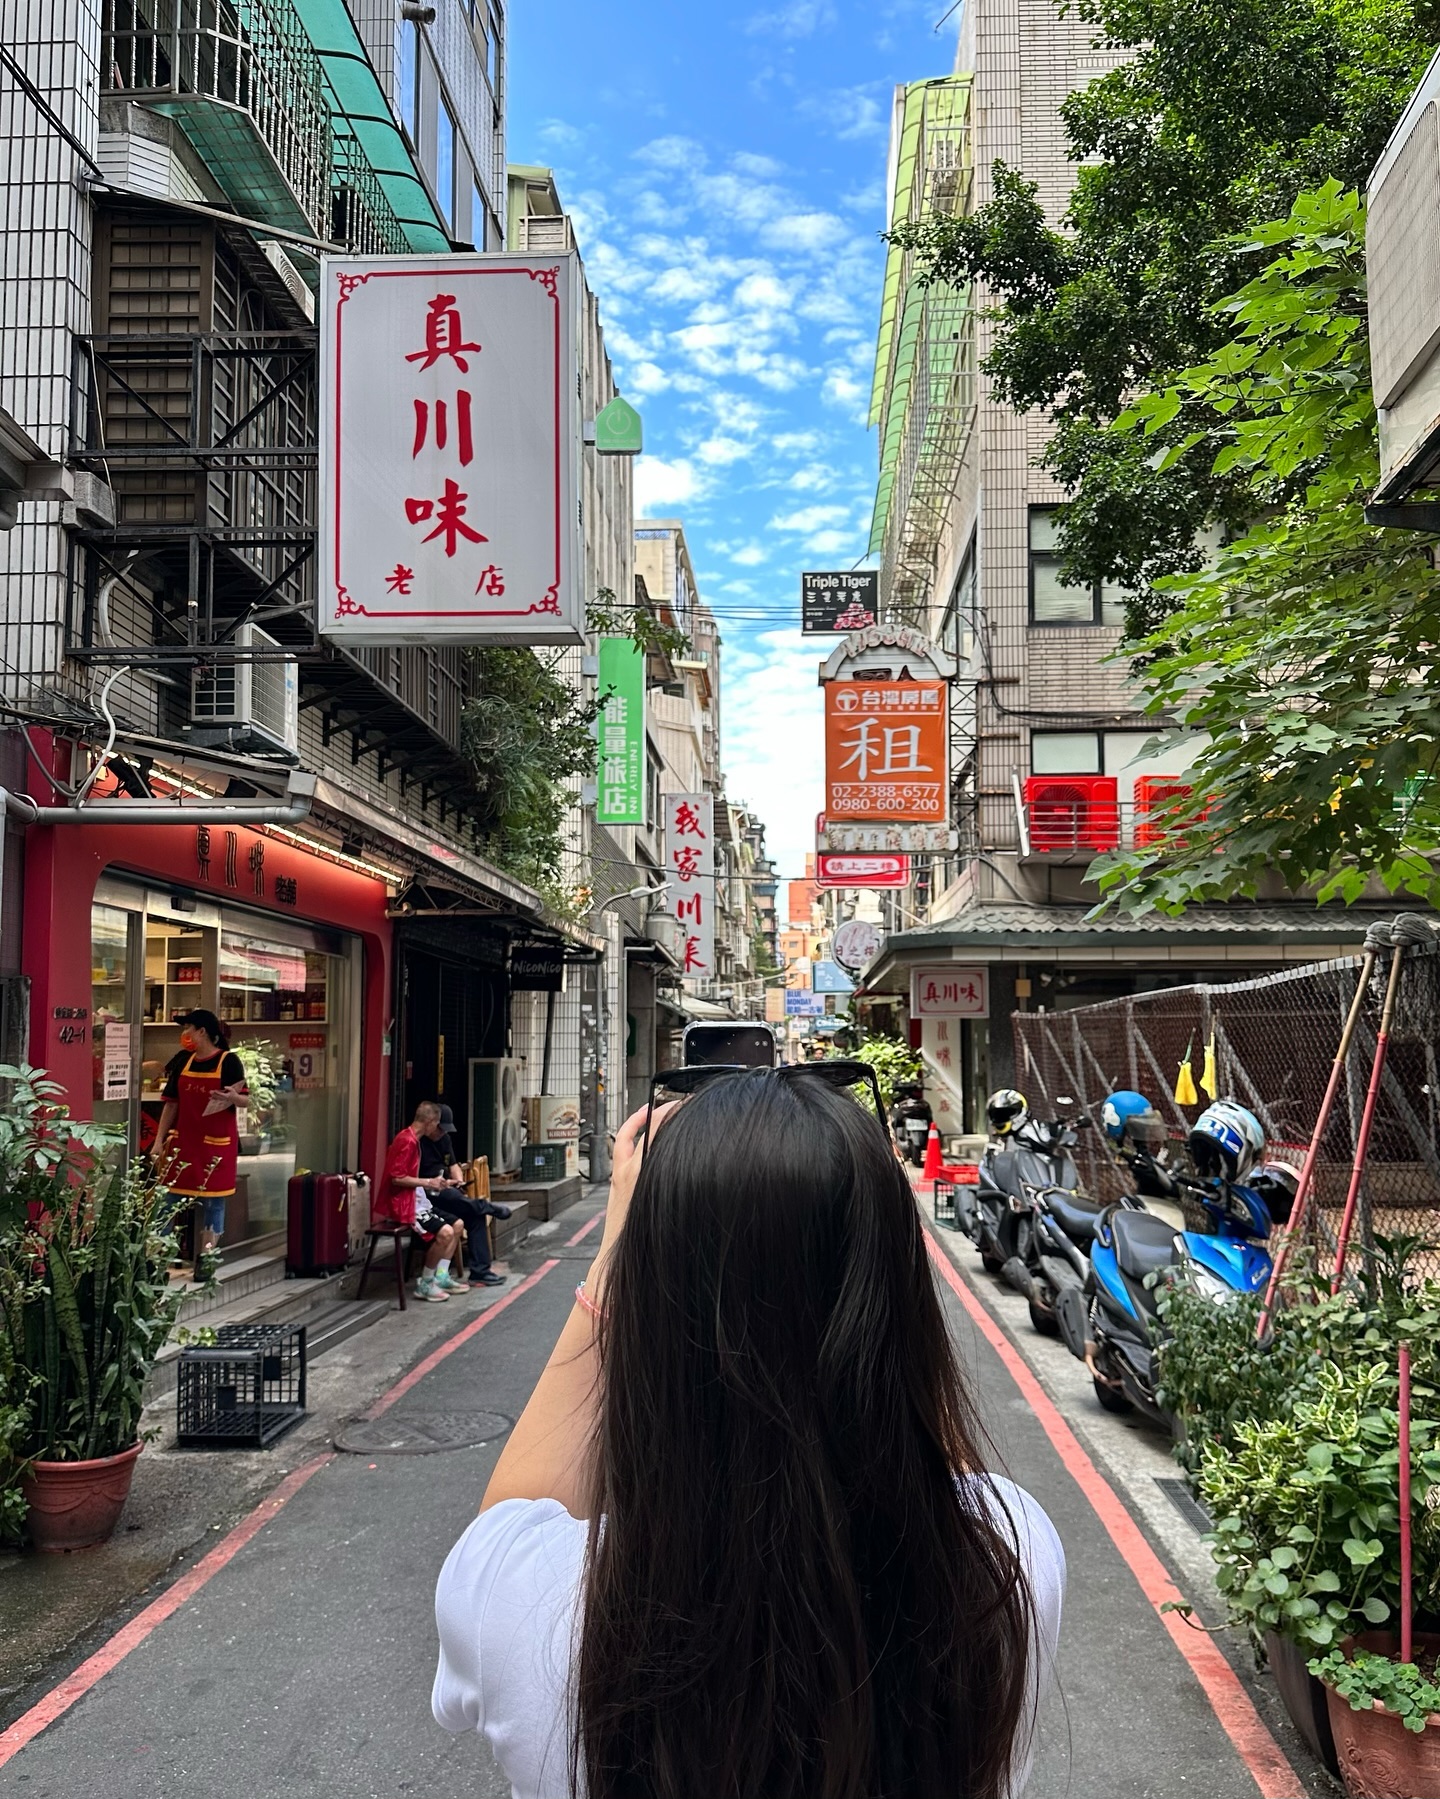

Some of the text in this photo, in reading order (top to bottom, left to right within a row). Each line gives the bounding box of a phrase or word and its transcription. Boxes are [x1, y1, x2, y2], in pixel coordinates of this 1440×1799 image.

[405, 294, 489, 558] 真川味
[385, 563, 505, 597] 老店
[804, 574, 871, 590] Triple Tiger
[603, 696, 628, 815] 能量旅店
[838, 717, 934, 781] 租
[832, 786, 940, 798] 02-2388-6577
[629, 797, 638, 815] INN
[832, 799, 940, 811] 0980-600-200
[513, 960, 562, 975] NicoNico
[922, 982, 979, 1003] 真川味
[59, 1025, 86, 1043] 42-1
[299, 1053, 313, 1077] 9
